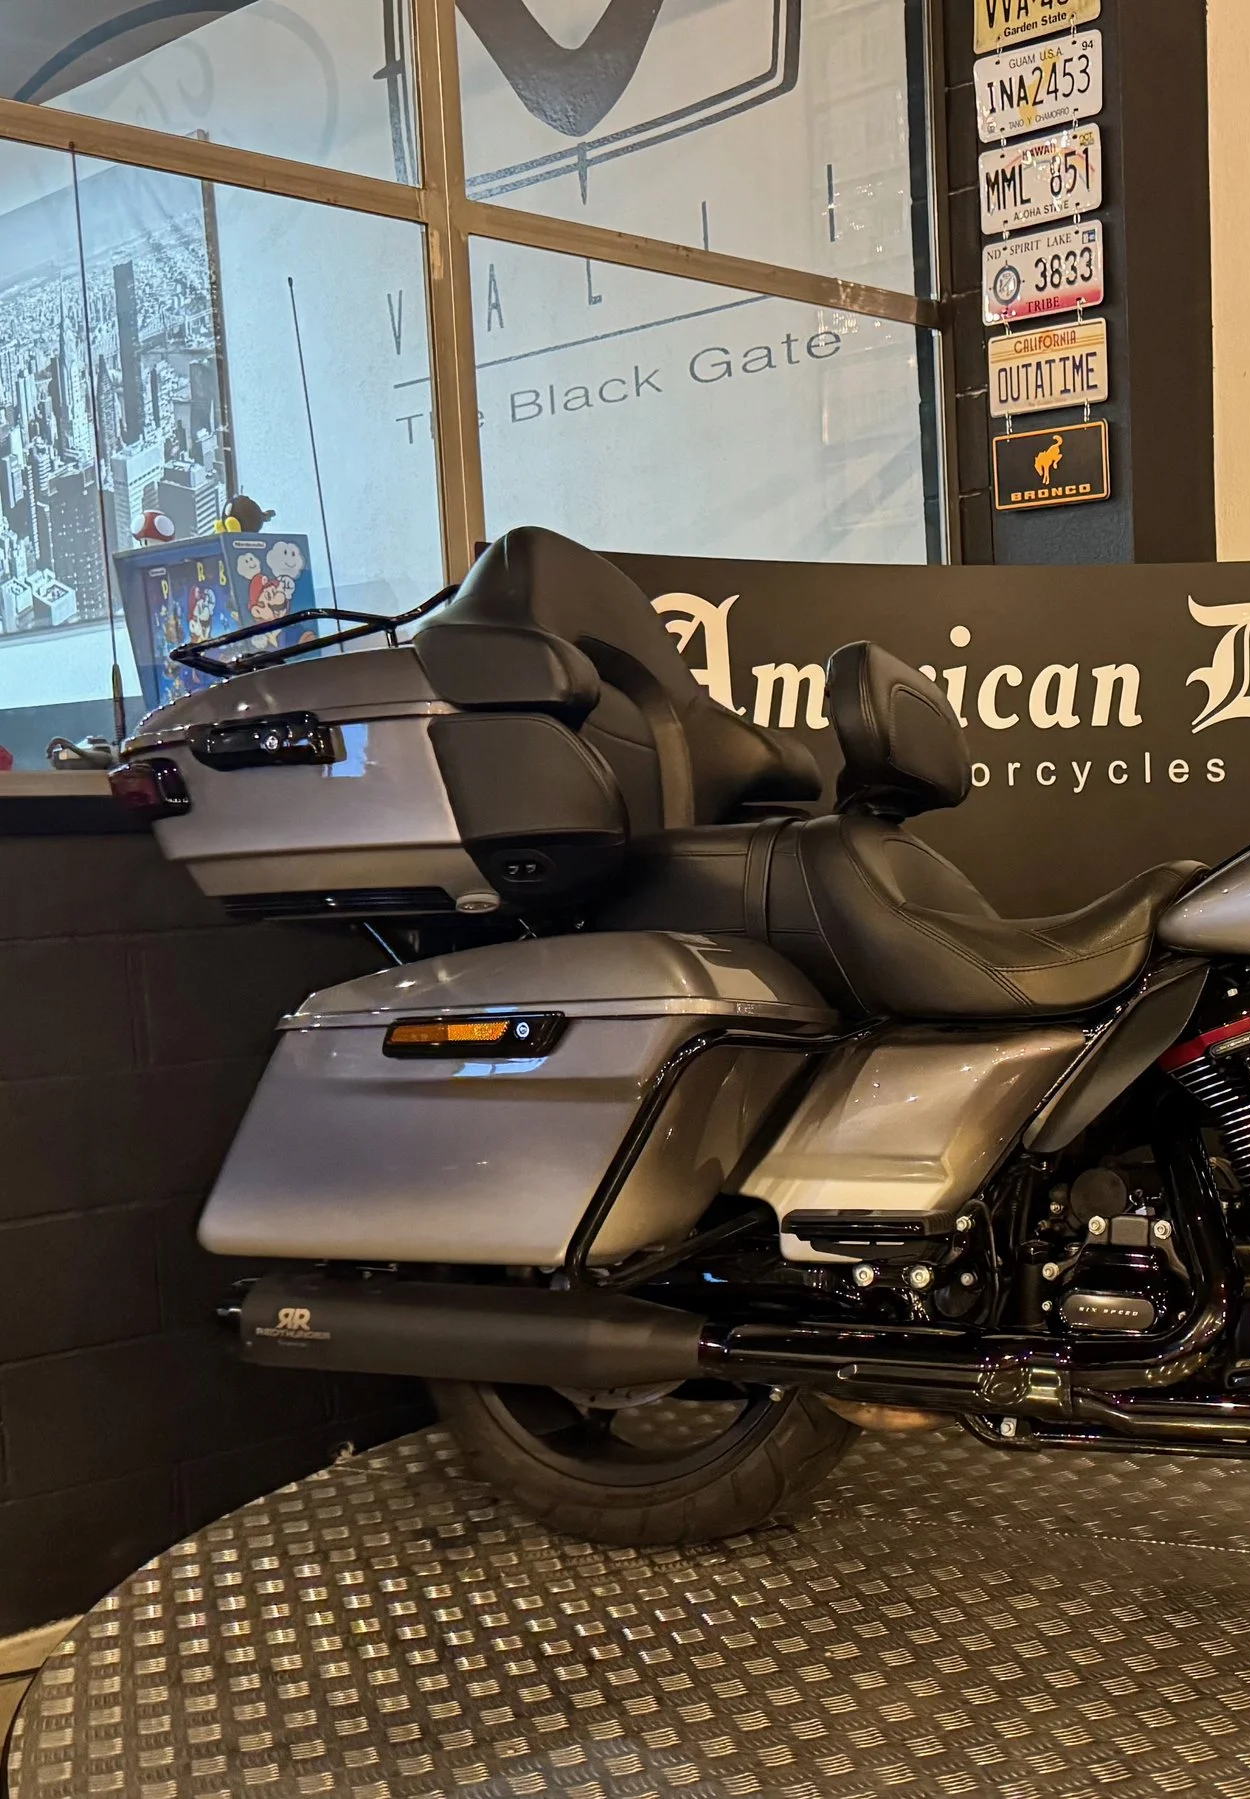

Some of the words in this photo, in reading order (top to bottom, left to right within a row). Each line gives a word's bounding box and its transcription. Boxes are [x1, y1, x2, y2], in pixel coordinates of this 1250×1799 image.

[1004, 20, 1037, 37] Garden
[1041, 12, 1067, 26] State
[1082, 40, 1094, 51] 94
[1009, 54, 1036, 69] GUAM
[987, 54, 1091, 114] INA2453
[986, 164, 1032, 214] MML
[1050, 147, 1091, 198] 851
[987, 249, 1002, 261] ND
[1009, 240, 1041, 255] SPIRIT
[1047, 233, 1072, 247] LAKE
[1034, 247, 1093, 292] 3833
[1026, 297, 1060, 313] TRIBE
[1014, 330, 1077, 354] CALIFORNIA
[510, 366, 663, 423] Black
[689, 330, 842, 383] Gate
[998, 352, 1098, 404] OUTATIME
[1011, 483, 1091, 502] BRONCO
[650, 592, 1143, 730] Amican
[970, 751, 1227, 794] orcycles
[1103, 1308, 1139, 1317] SPEED
